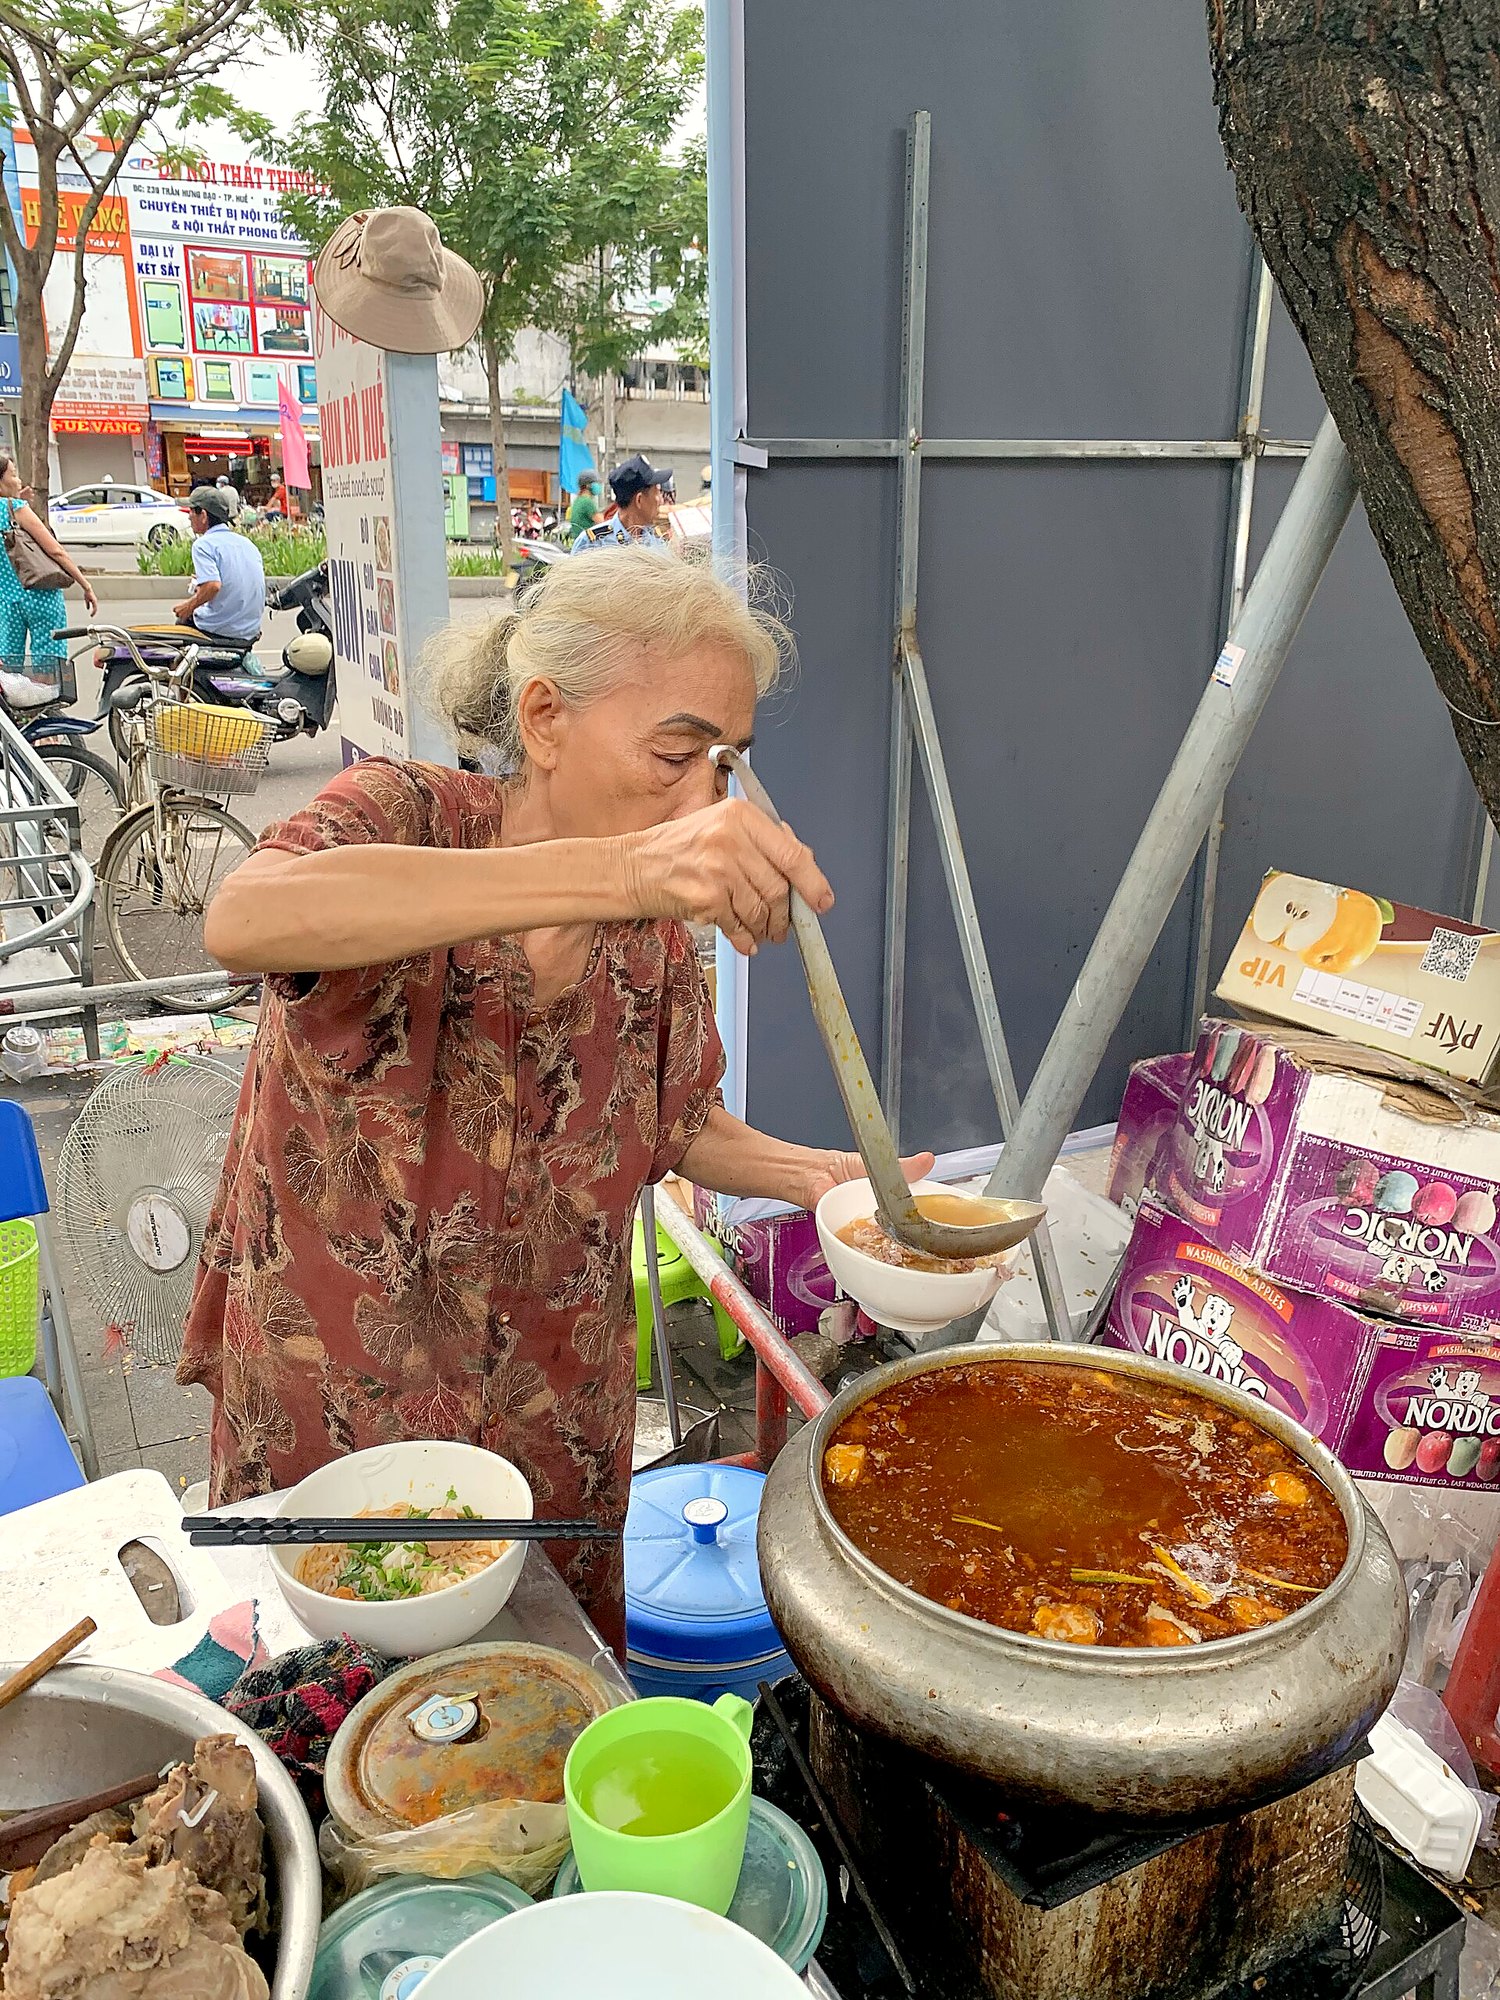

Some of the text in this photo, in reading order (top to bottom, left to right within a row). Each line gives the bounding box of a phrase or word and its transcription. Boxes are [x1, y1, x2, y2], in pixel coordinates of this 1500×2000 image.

[171, 220, 180, 230] &
[239, 226, 278, 240] PHONG
[320, 354, 387, 469] BÚN BÒ HUẾ
[1189, 1079, 1253, 1150] NORDIC
[1328, 1141, 1341, 1152] WA
[1392, 1158, 1412, 1170] EAST
[1341, 1208, 1475, 1265] NORDIC
[1186, 1245, 1249, 1282] WASHINGTON
[1252, 1276, 1286, 1312] APPLES
[1331, 1278, 1360, 1296] PPLES
[1399, 1301, 1439, 1313] WASHIN
[1436, 1344, 1490, 1356] WASHITON
[1403, 1397, 1500, 1436] NORDIC
[1348, 1469, 1376, 1478] TRIBUTED
[1377, 1471, 1386, 1479] BY
[1386, 1473, 1418, 1483] NORTHERN
[1419, 1476, 1438, 1485] FRUIT
